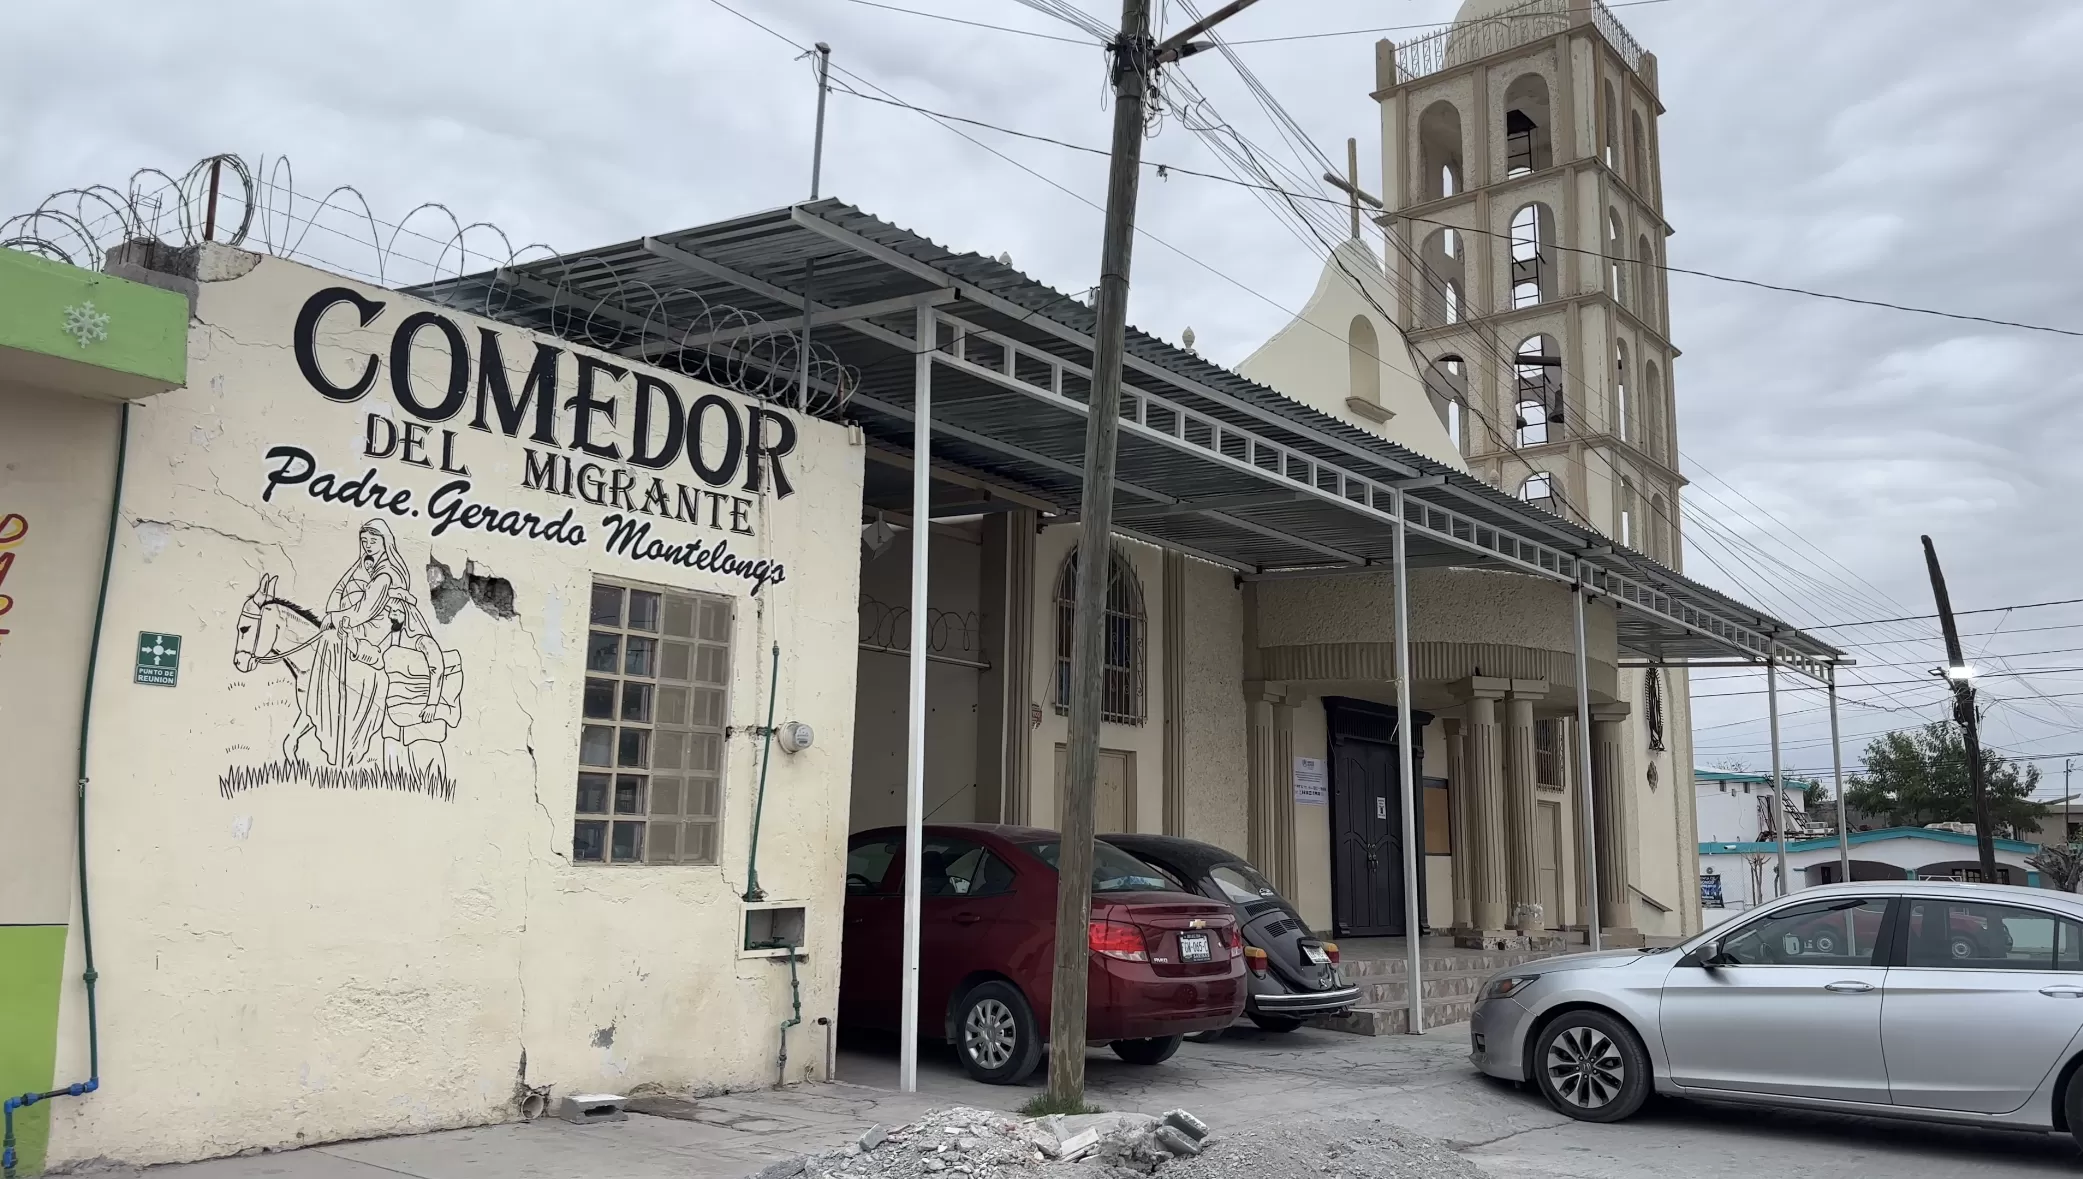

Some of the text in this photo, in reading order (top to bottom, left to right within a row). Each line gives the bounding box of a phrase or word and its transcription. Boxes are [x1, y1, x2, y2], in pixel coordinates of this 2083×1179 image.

[294, 286, 798, 501] COMEDOR
[262, 446, 786, 597] Padre. Gerardo Montelongo
[363, 412, 756, 537] DEL MIGRANTE
[137, 674, 175, 685] REUNION
[138, 667, 163, 676] PUNTO
